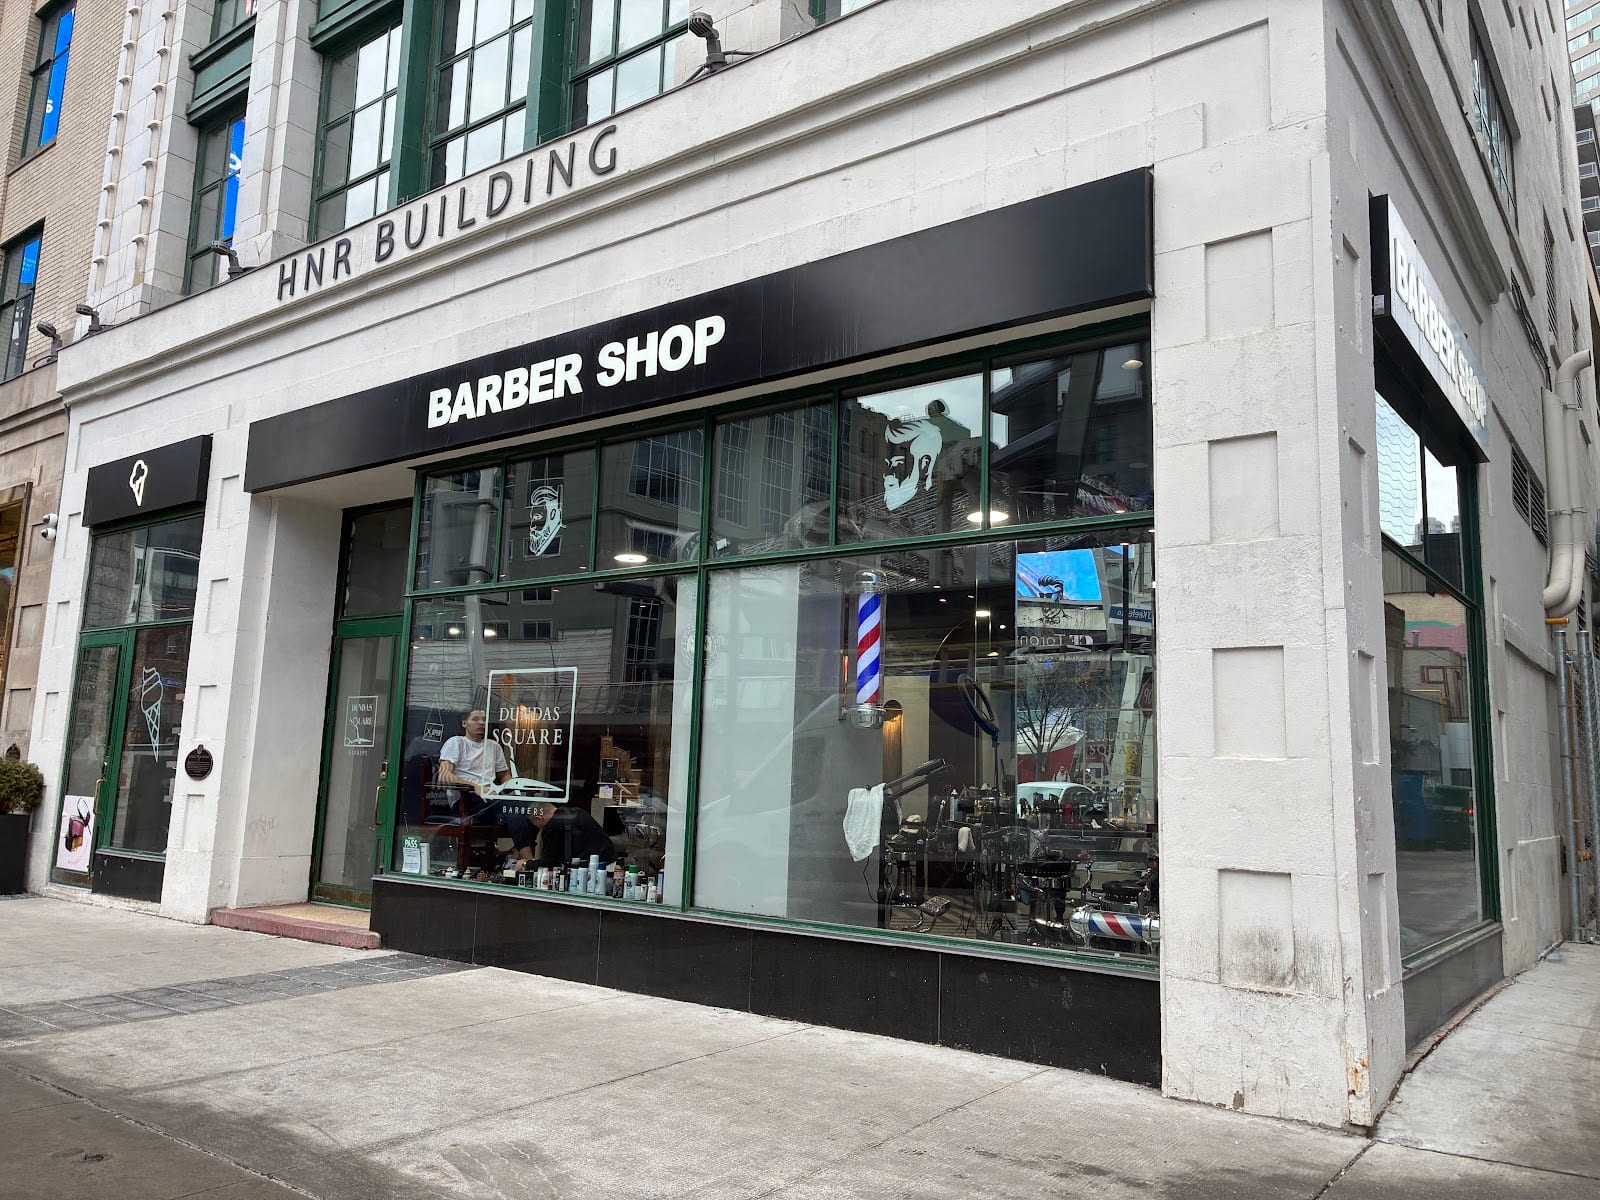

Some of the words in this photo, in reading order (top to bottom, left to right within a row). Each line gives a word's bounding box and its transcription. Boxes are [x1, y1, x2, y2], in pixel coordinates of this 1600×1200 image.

[276, 237, 351, 300] HNR
[374, 124, 618, 262] BUILDING
[1394, 237, 1456, 385] BARBER
[1457, 348, 1488, 428] SHOP
[427, 352, 583, 429] BARBER
[596, 315, 726, 388] SHOP
[351, 703, 373, 712] DUNDAS
[499, 706, 560, 721] DUNDAS
[492, 727, 563, 746] SQUARE
[502, 805, 544, 816] BARBERS
[404, 839, 418, 848] PASS
